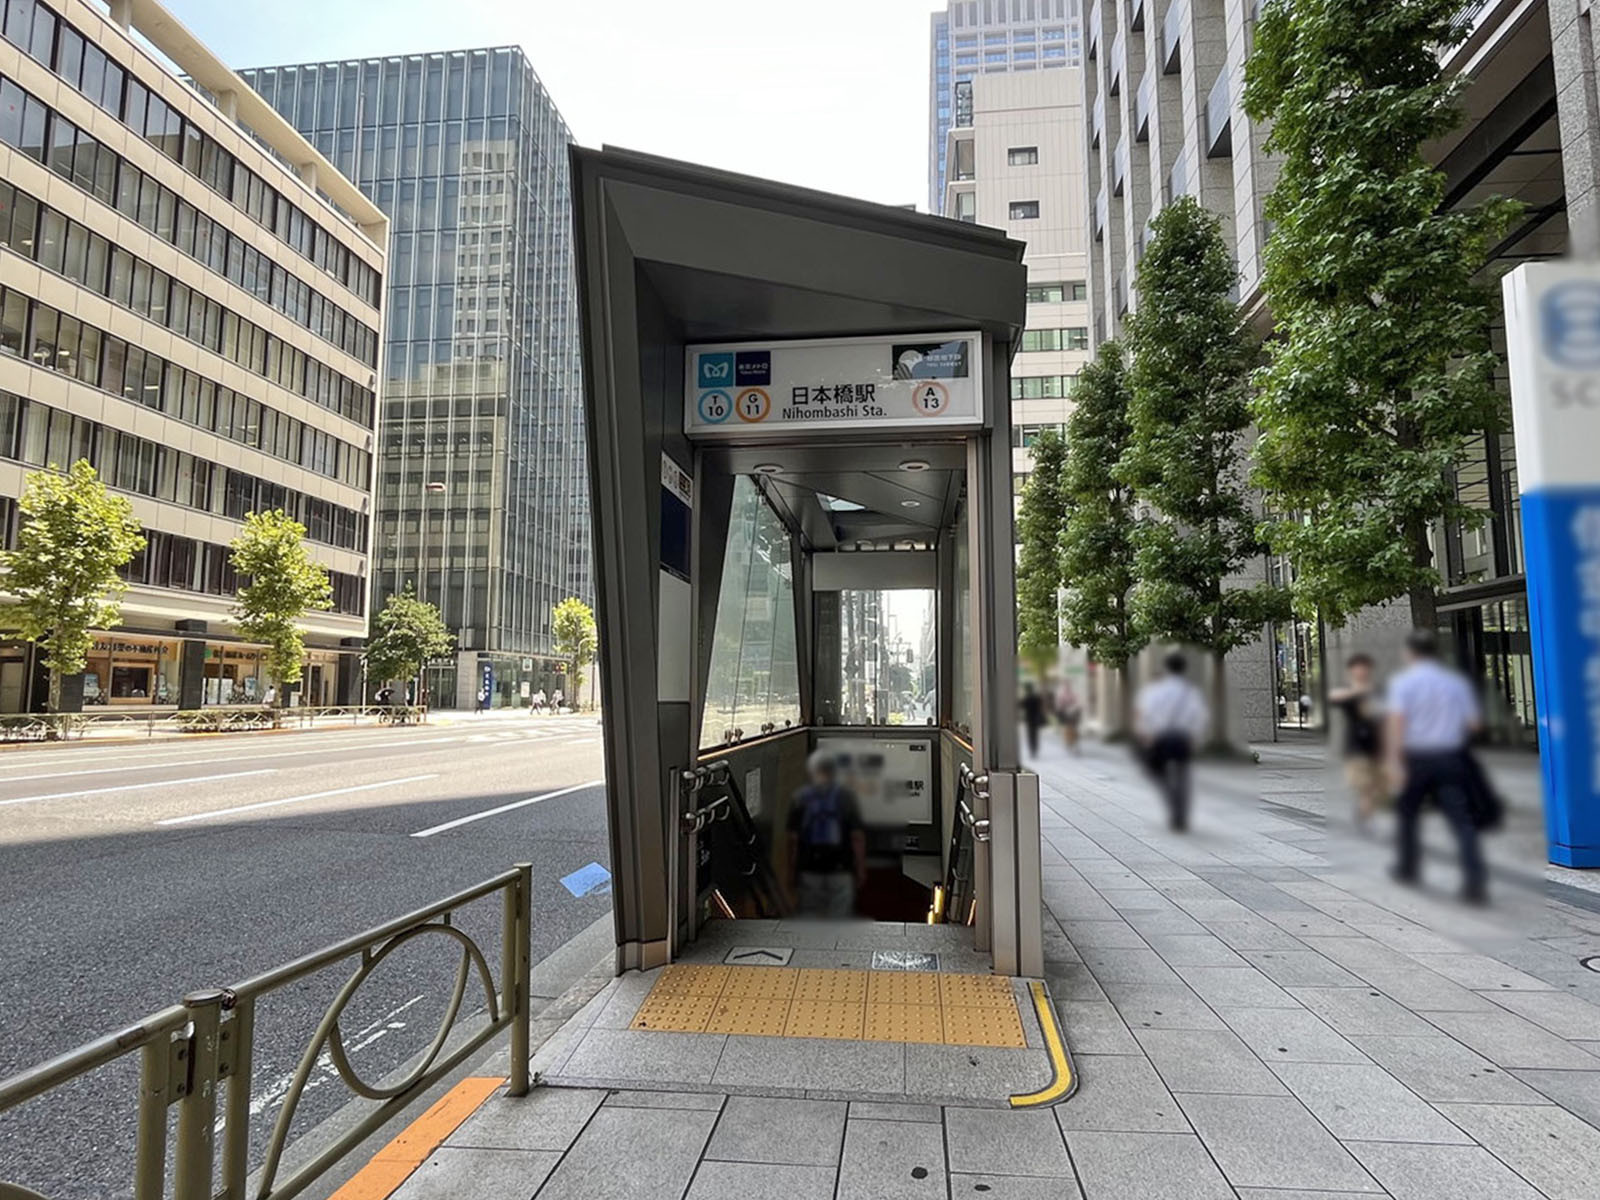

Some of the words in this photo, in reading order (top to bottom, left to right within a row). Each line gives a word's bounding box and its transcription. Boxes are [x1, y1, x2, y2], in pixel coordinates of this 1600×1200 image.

[792, 383, 876, 405] 日本橋駅
[925, 387, 935, 397] A
[712, 395, 719, 405] T
[748, 393, 758, 404] G
[923, 397, 940, 409] 13
[708, 405, 724, 417] 10
[746, 404, 760, 415] 11
[782, 405, 859, 419] Nihombashi
[862, 404, 888, 417] Sta.
